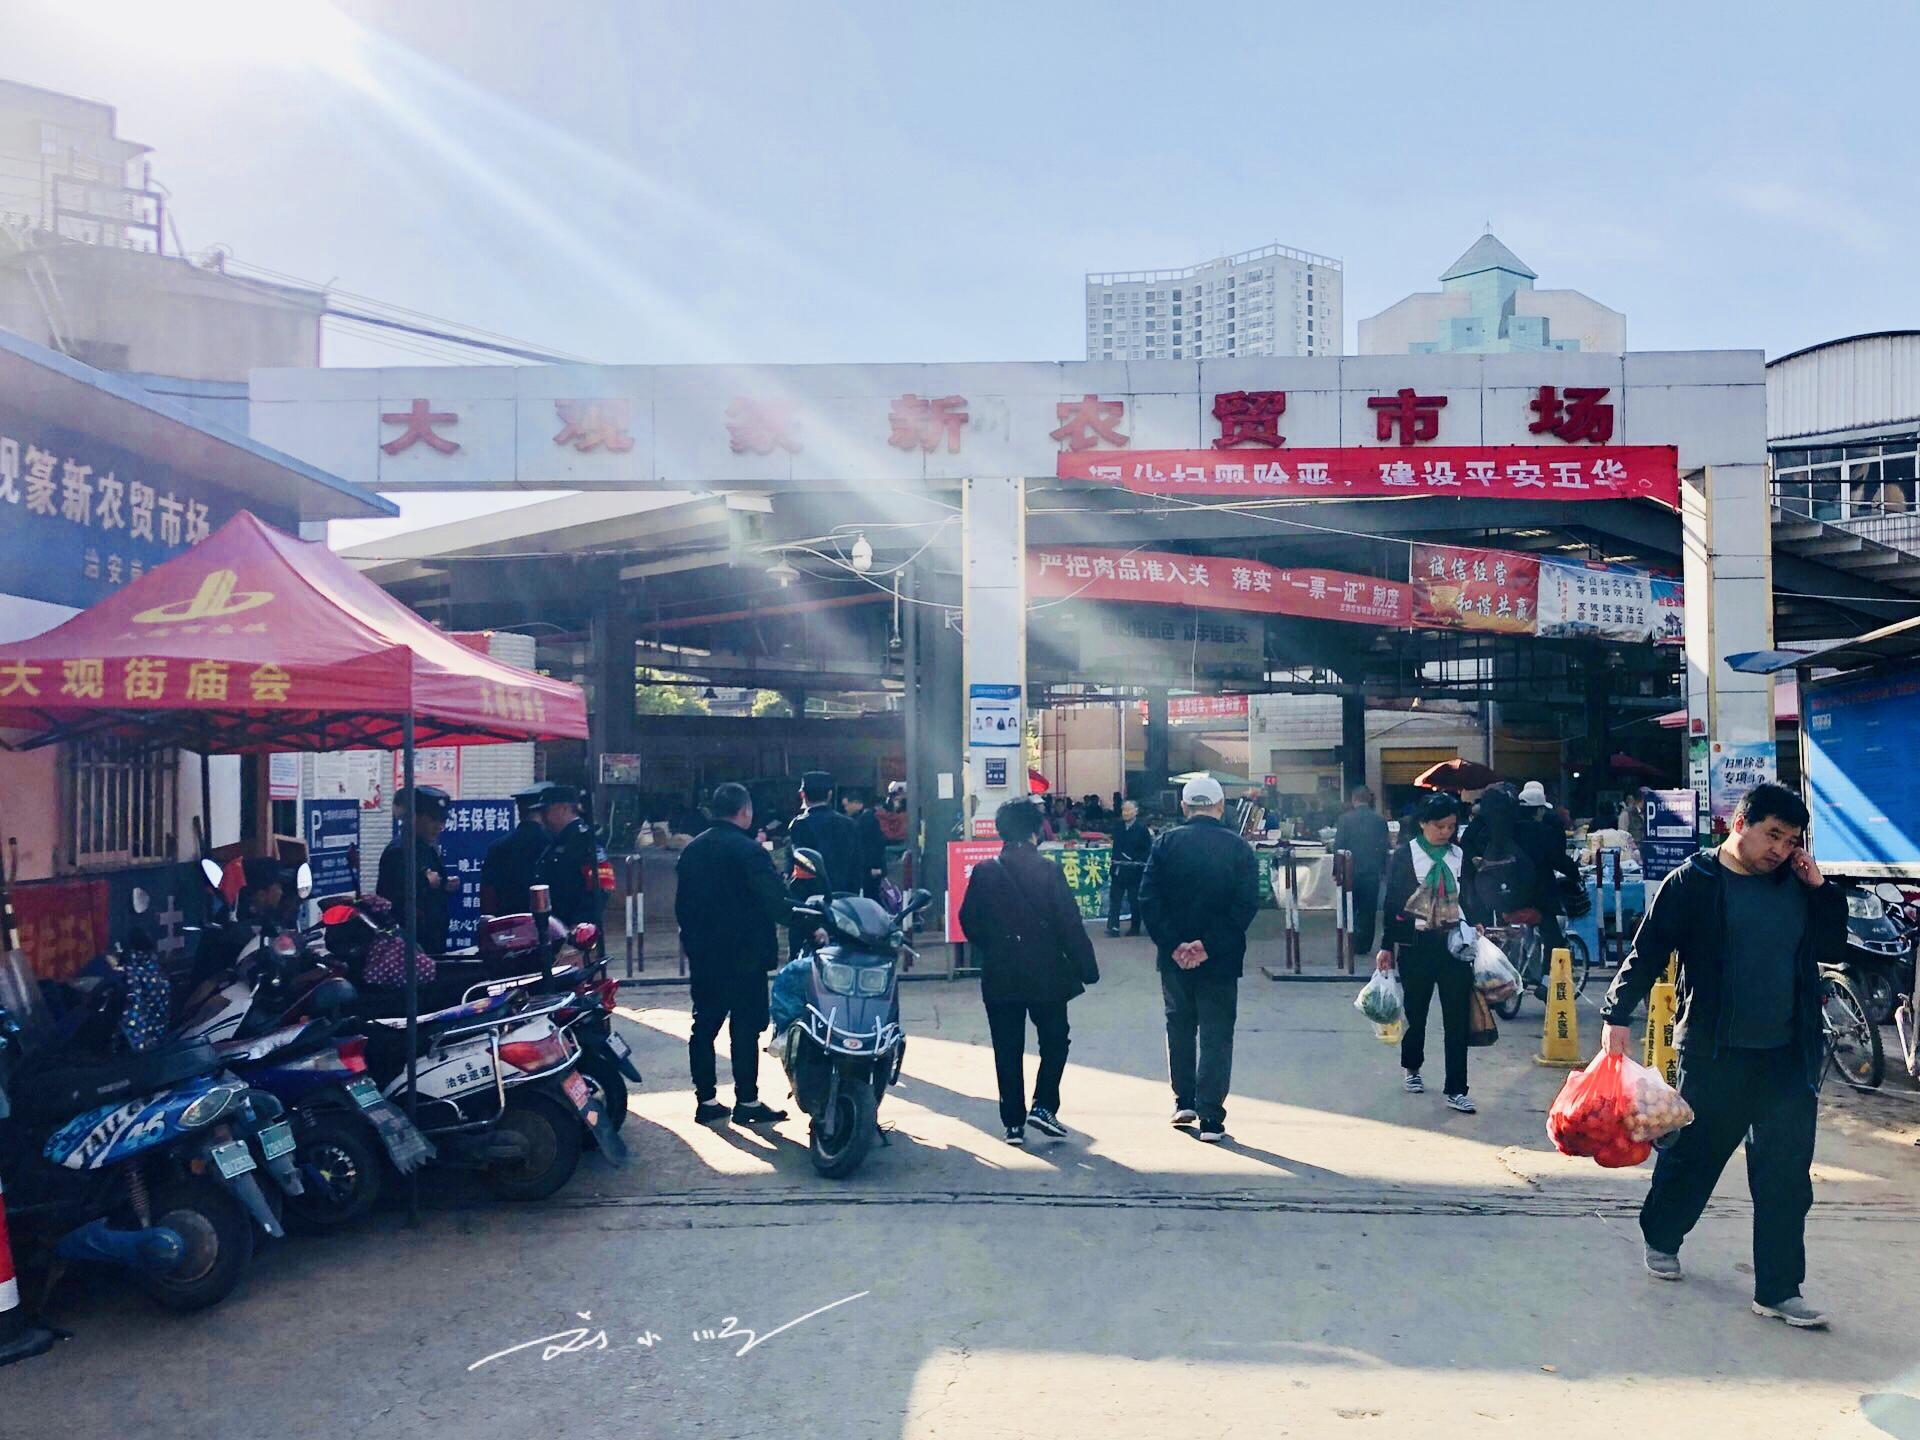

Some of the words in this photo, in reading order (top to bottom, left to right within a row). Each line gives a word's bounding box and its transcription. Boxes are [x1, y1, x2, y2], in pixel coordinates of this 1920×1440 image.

[1038, 552, 1209, 588] 严把肉品准入关
[1428, 555, 1509, 587] 诚信经营
[1455, 591, 1529, 622] 和谐共赢
[1, 657, 292, 702] 大观街庙会
[1724, 757, 1766, 769] 扫黑除恶
[445, 805, 521, 832] 动车保管站
